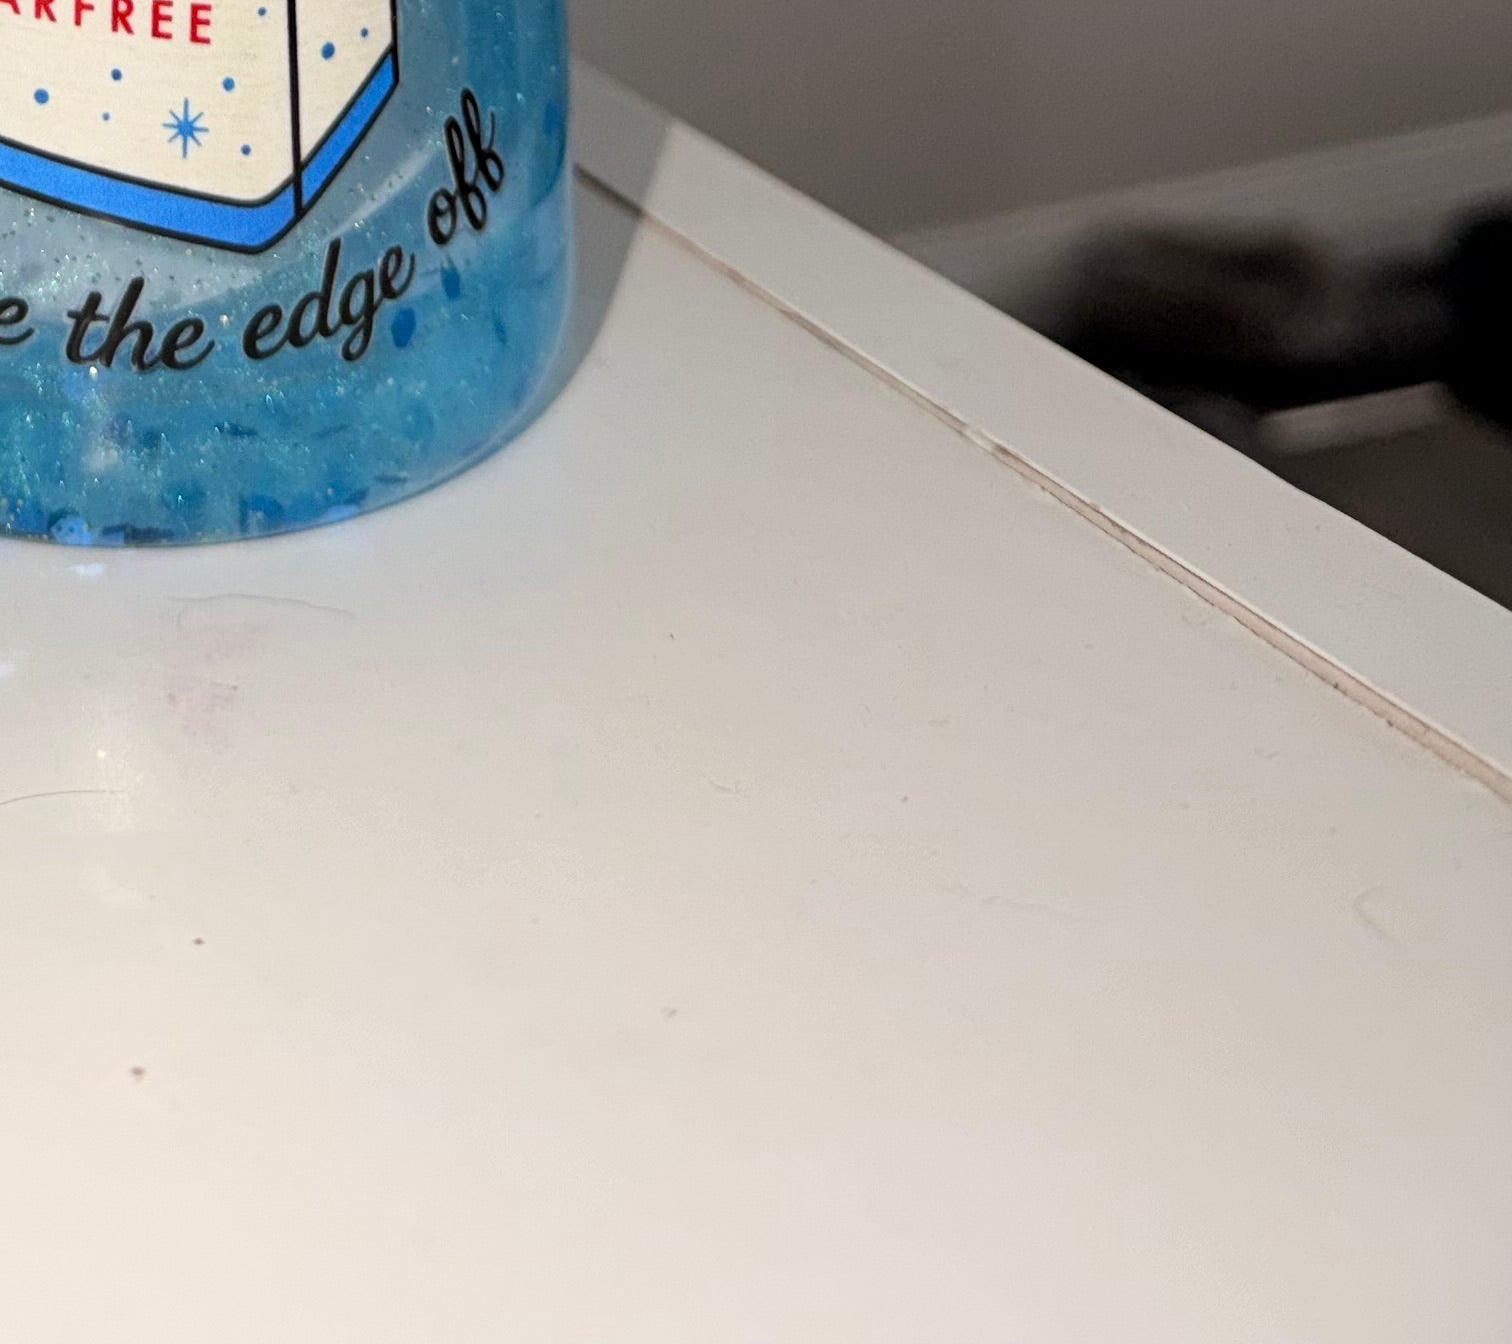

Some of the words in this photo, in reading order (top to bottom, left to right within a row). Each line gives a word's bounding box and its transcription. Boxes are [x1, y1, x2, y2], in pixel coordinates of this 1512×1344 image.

[64, 278, 216, 371] the
[242, 238, 416, 362] edge
[427, 88, 506, 248] off
